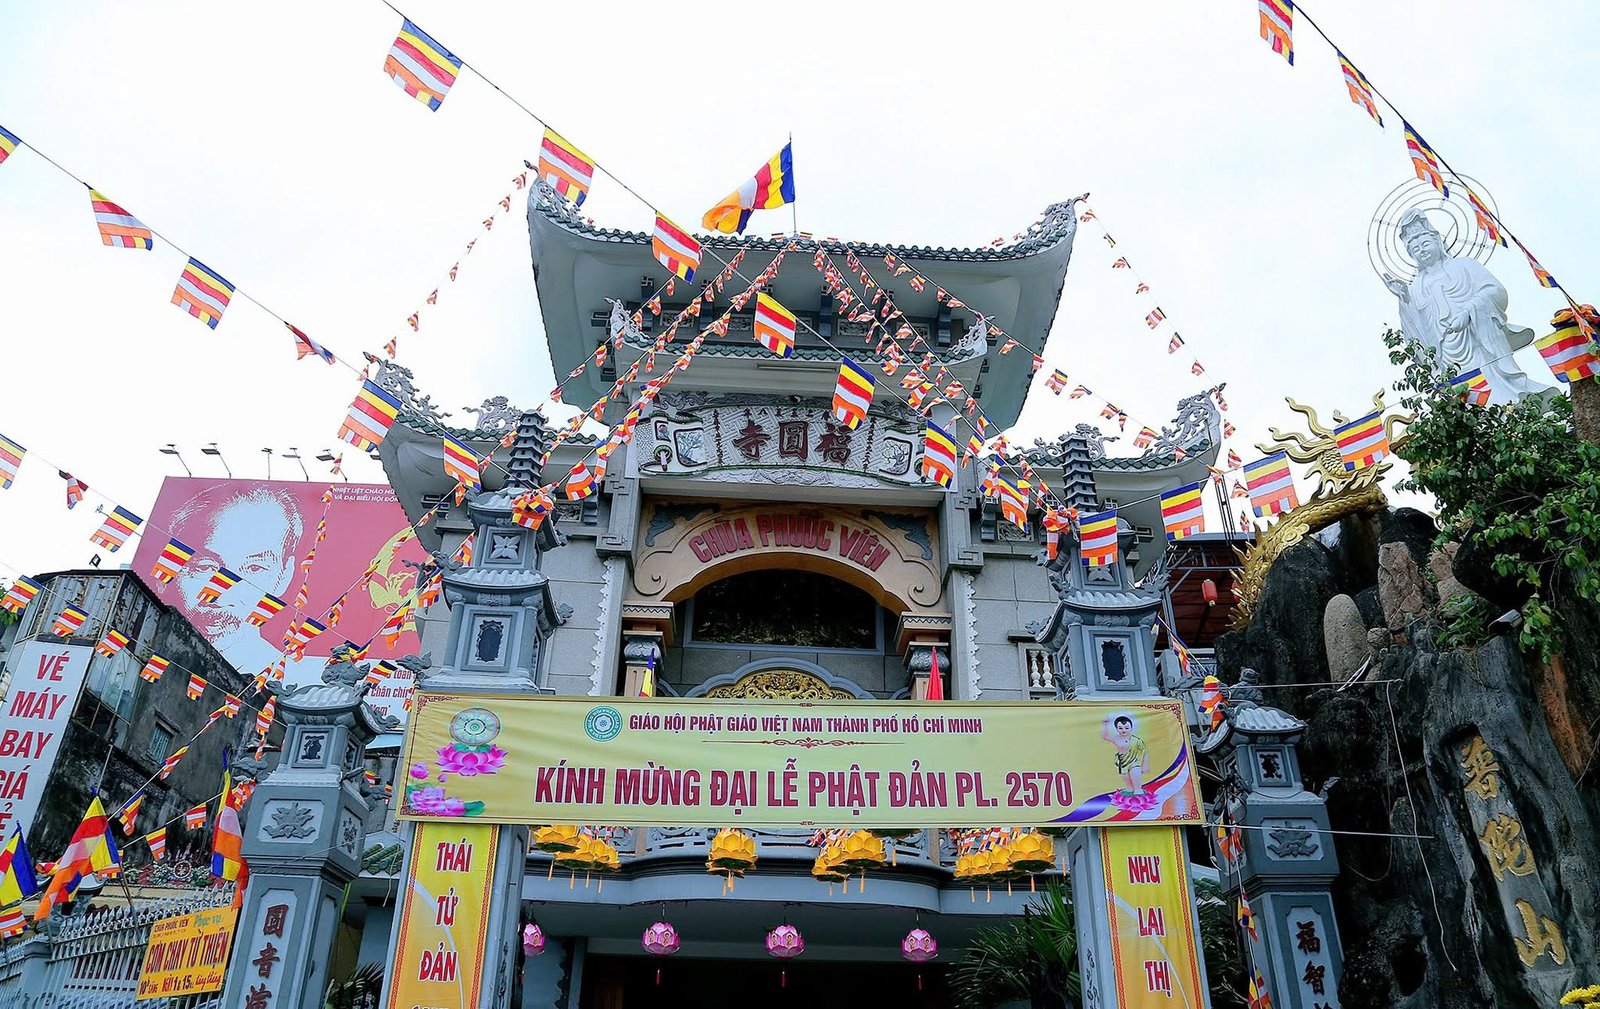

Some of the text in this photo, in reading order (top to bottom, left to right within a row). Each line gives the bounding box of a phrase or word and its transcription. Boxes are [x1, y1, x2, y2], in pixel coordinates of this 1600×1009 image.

[689, 518, 755, 563] CHÙA
[37, 651, 70, 682] VÉ
[9, 687, 67, 720] MÁY
[630, 712, 983, 735] GIÁO HỘI PHẬT GIÁO VIỆT NAM THÀNH PHỐ HỒ CHÍ MINH
[0, 729, 54, 760] BAY
[534, 758, 1074, 816] KÍNH MỪNG ĐẠI LỄ PHẬT ĐẢN PL. 2570
[436, 838, 473, 872] THÁI
[436, 887, 459, 926] TỬ
[1127, 855, 1173, 999] NHƯ LAI THỊ
[146, 940, 166, 974] CƠM
[164, 938, 189, 971] CHAY
[200, 926, 230, 968] THIỆN
[418, 941, 457, 982] ĐẢN
[1296, 920, 1332, 1009] 福智
